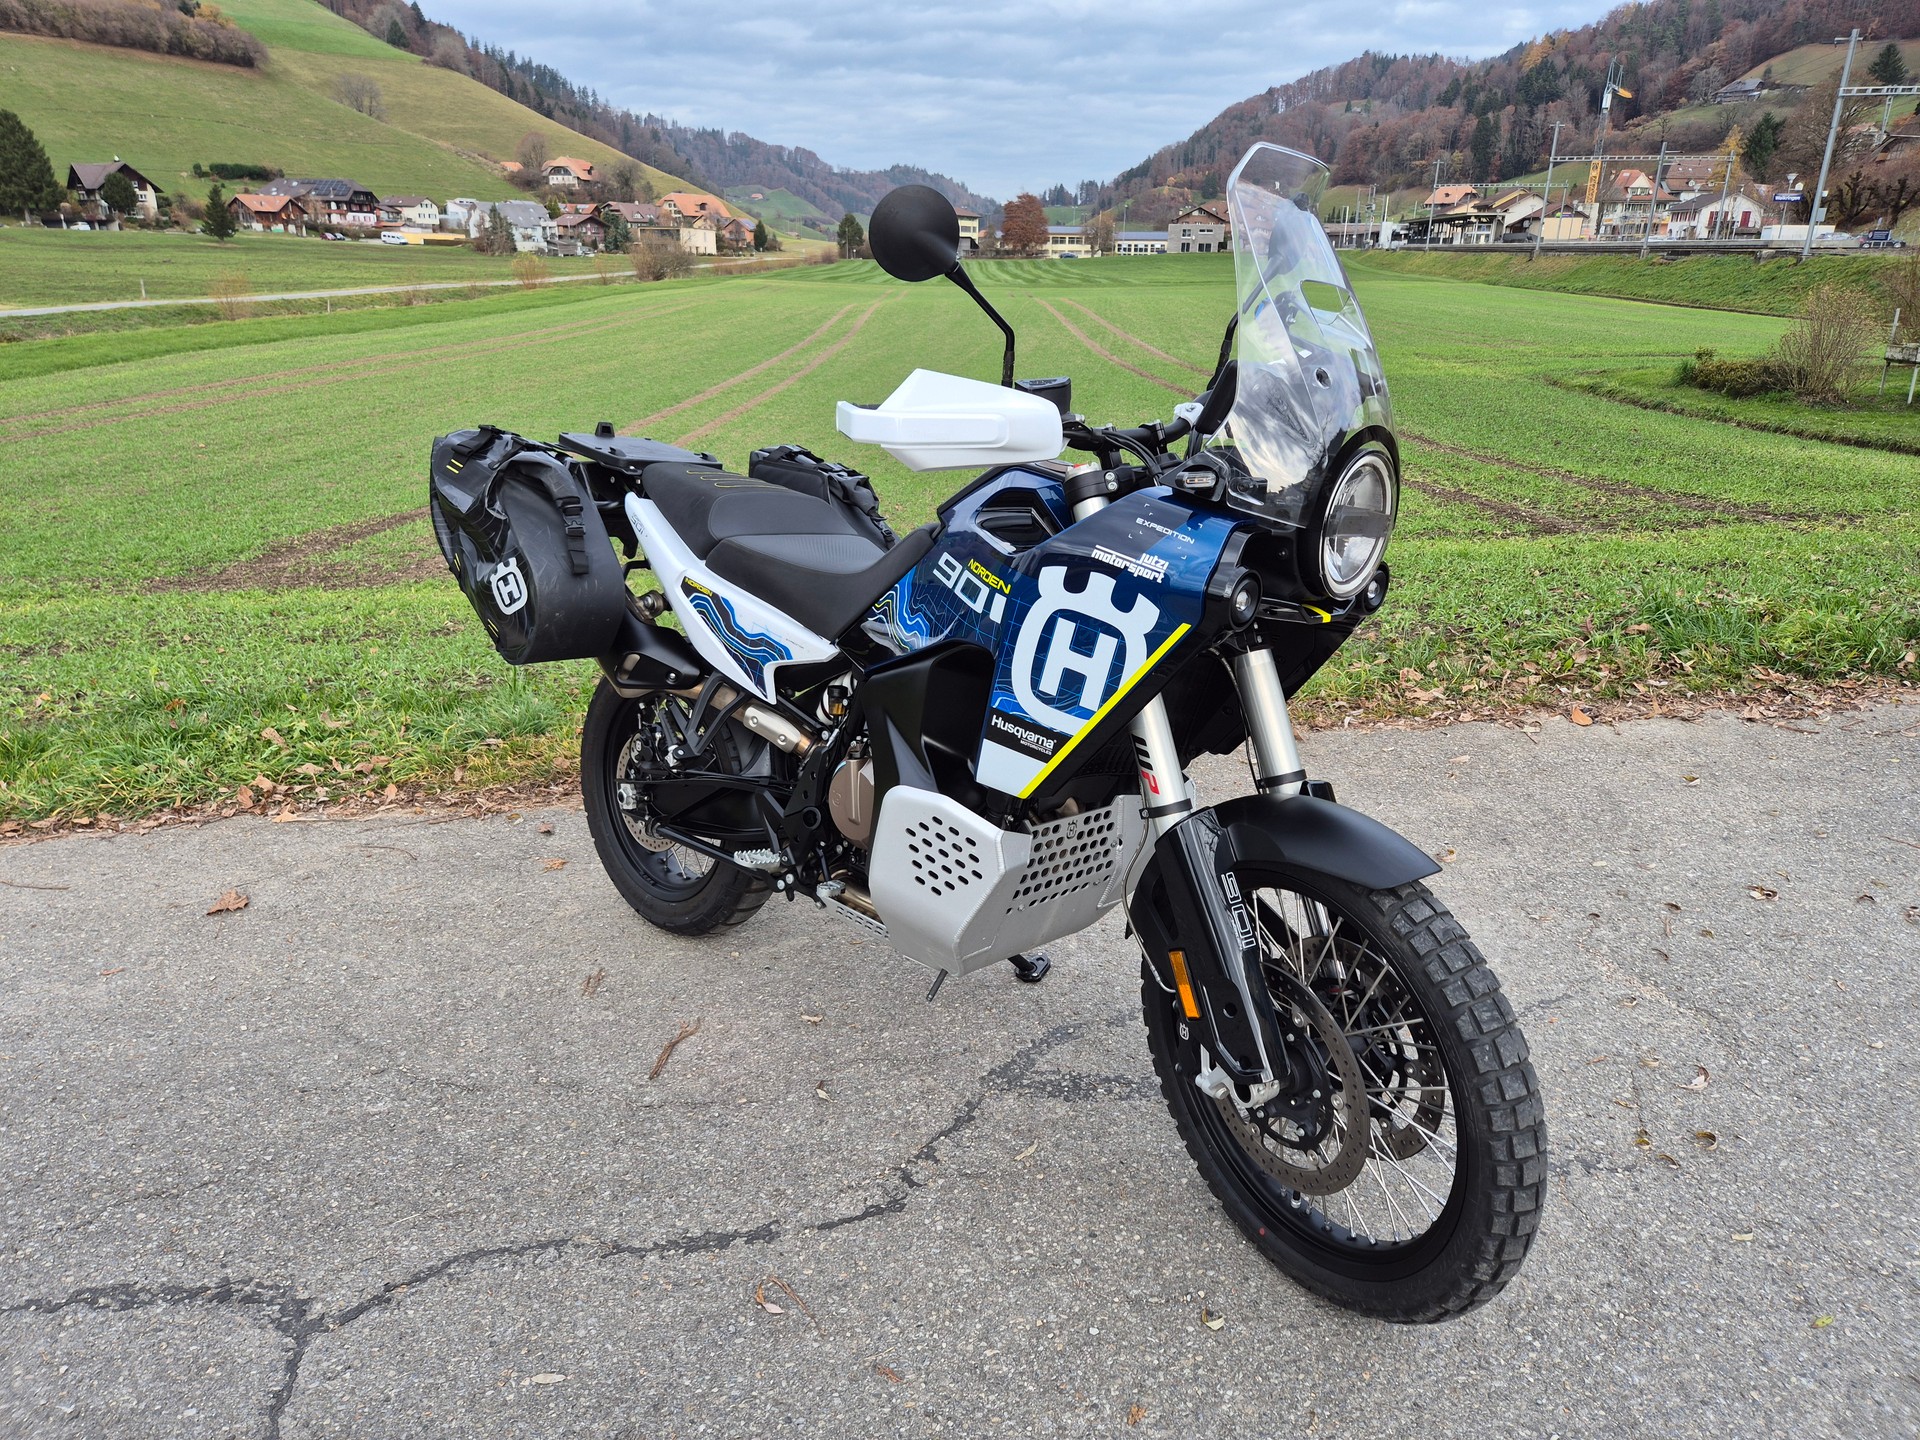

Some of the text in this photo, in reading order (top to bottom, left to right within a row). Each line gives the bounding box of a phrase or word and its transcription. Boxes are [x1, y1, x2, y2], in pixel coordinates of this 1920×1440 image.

[1135, 517, 1195, 545] EXPEDITION
[967, 558, 1012, 595] NORDEN
[1091, 547, 1166, 584] motorsport
[684, 577, 713, 597] NORDEN
[932, 551, 1007, 624] 901
[1020, 739, 1052, 756] MOTORCYCLES
[1221, 871, 1257, 950] 901
